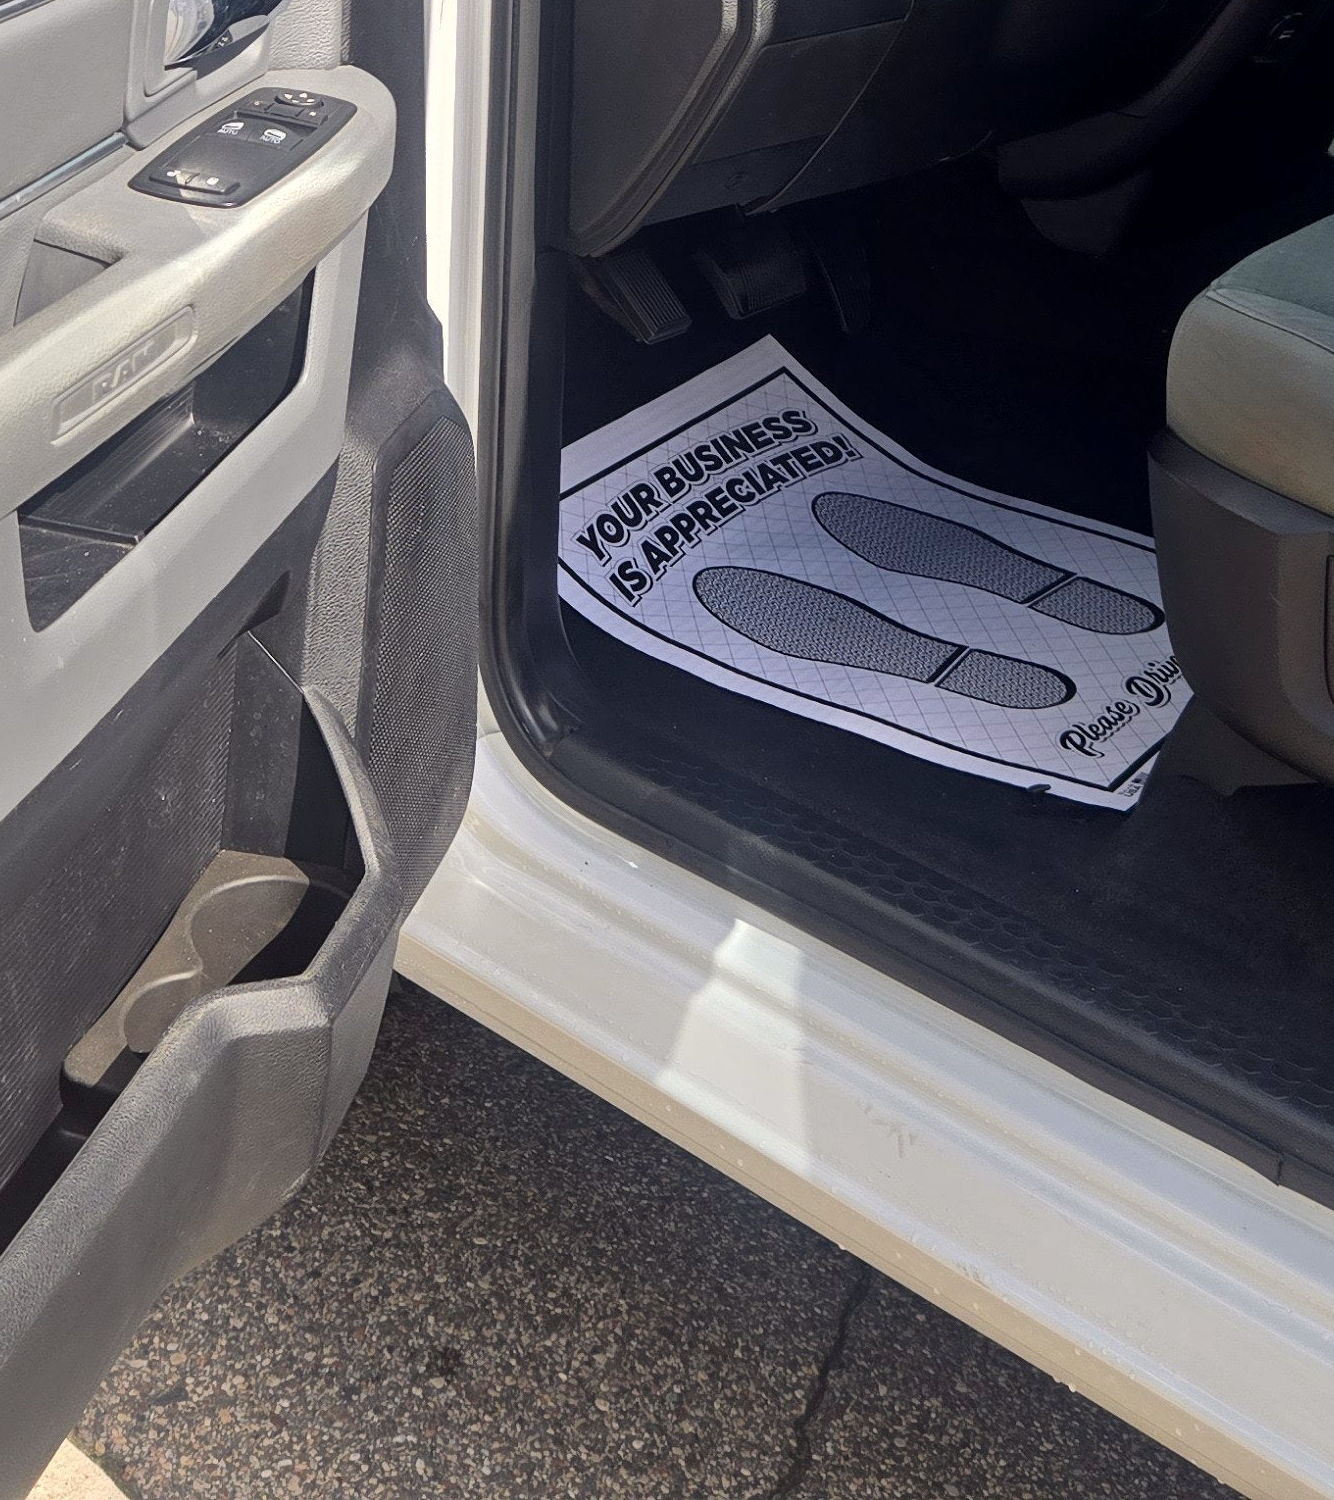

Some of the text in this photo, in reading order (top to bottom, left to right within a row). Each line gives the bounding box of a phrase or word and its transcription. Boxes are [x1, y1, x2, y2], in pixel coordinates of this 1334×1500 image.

[259, 134, 281, 144] AUTO
[576, 410, 814, 563] YOUR BUSINESS
[608, 435, 857, 603] IS APPRECIATED!
[1059, 654, 1181, 758] Please Driv
